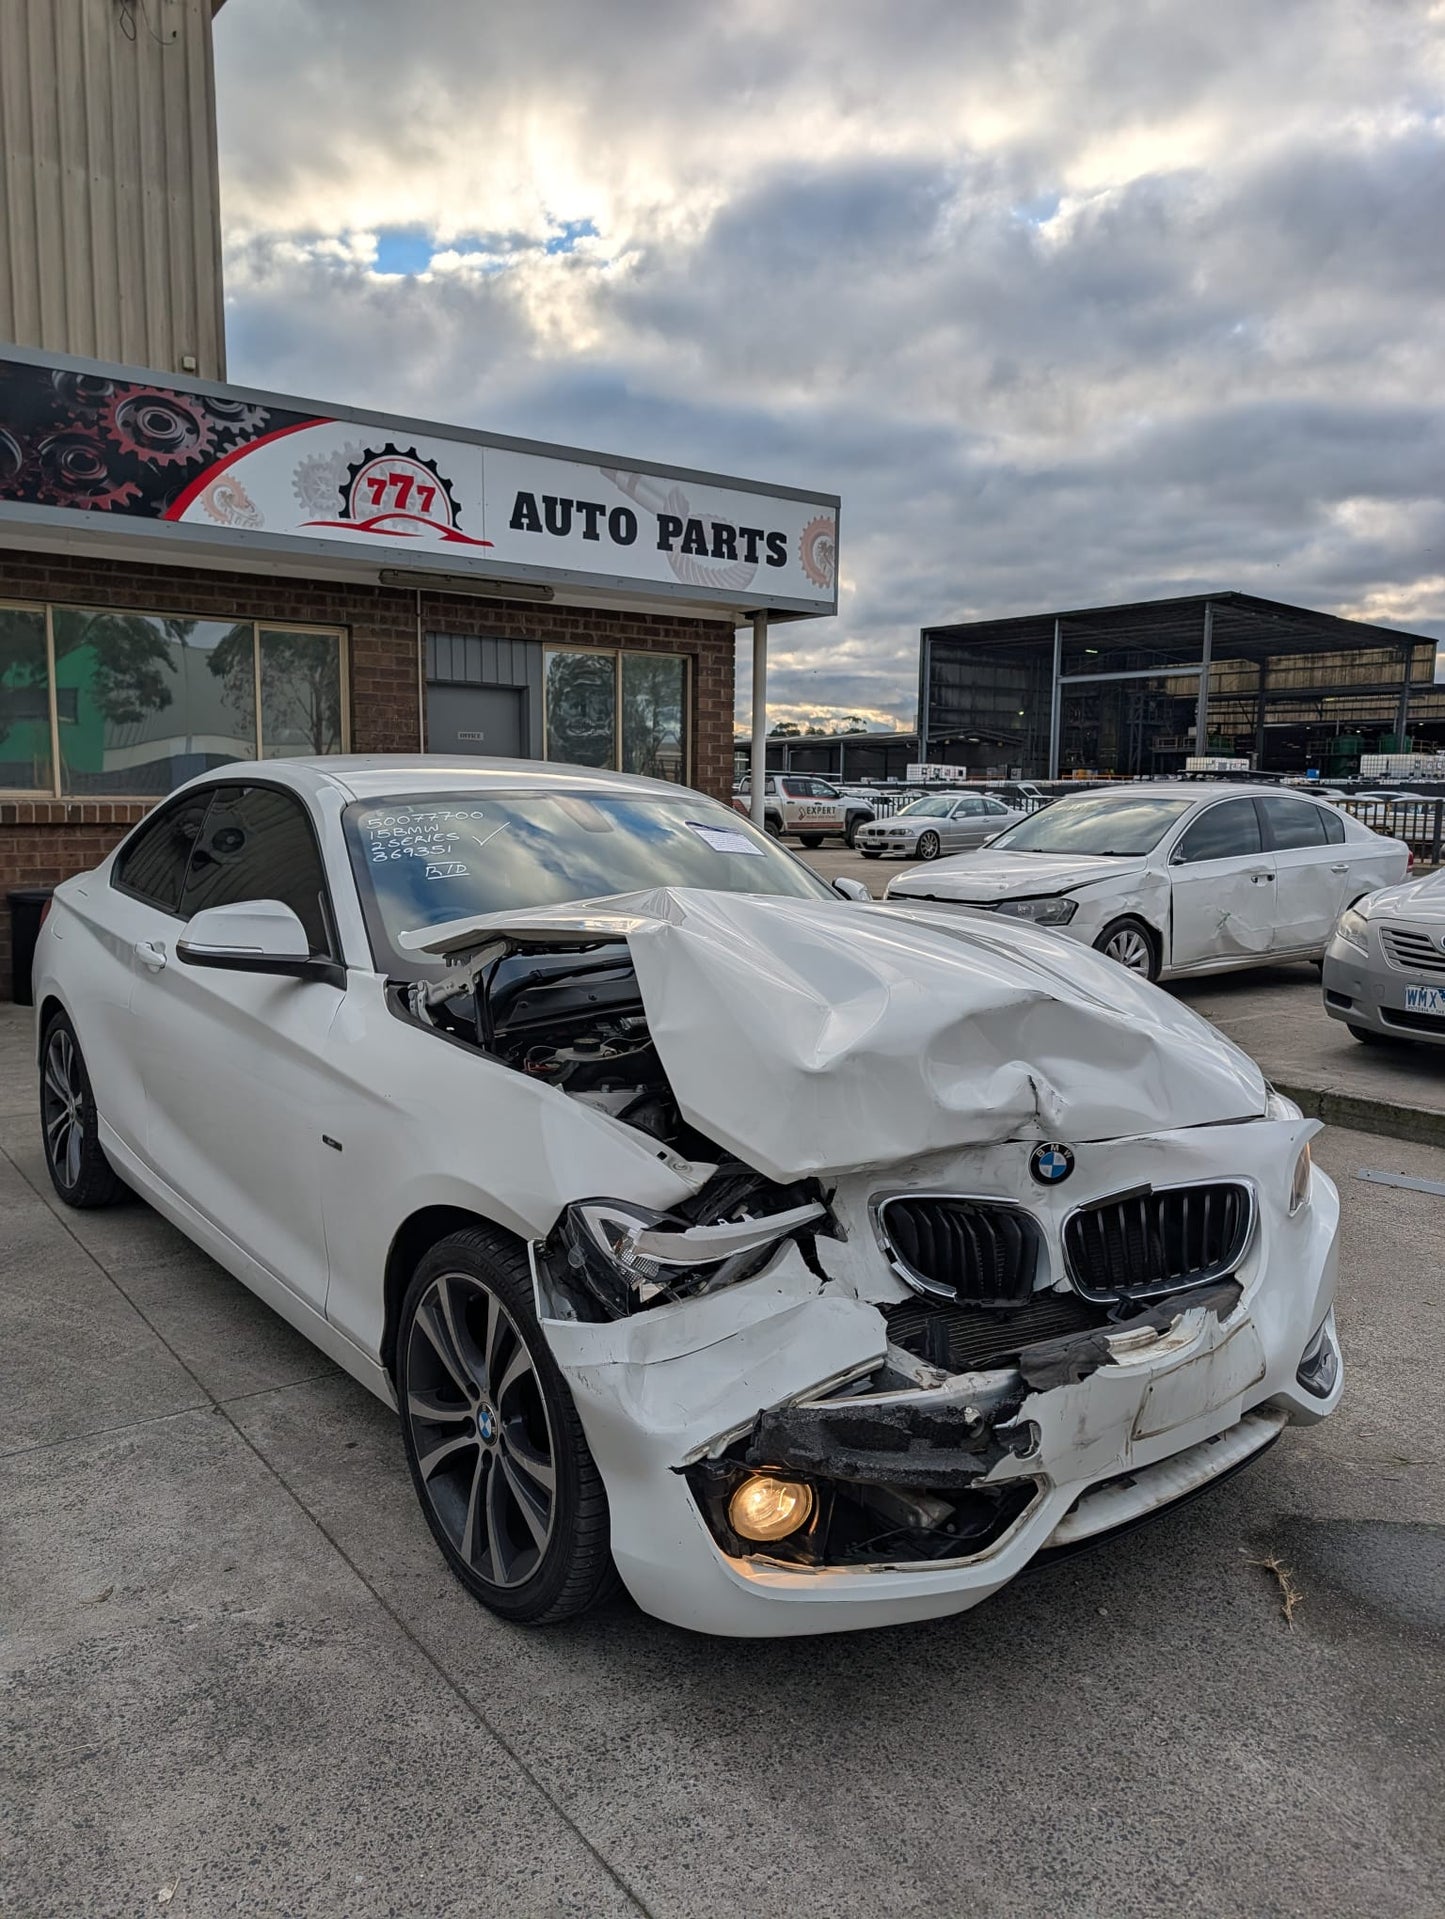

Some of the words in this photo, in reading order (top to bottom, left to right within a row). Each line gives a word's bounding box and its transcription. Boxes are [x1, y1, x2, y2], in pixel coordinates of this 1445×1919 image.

[367, 472, 436, 513] 777
[509, 490, 638, 546] AUTO
[656, 513, 787, 567] PARTS
[806, 806, 836, 814] EXPERT
[366, 811, 484, 830] 50077700
[1407, 989, 1437, 1008] WMX
[1035, 1144, 1073, 1158] BMW
